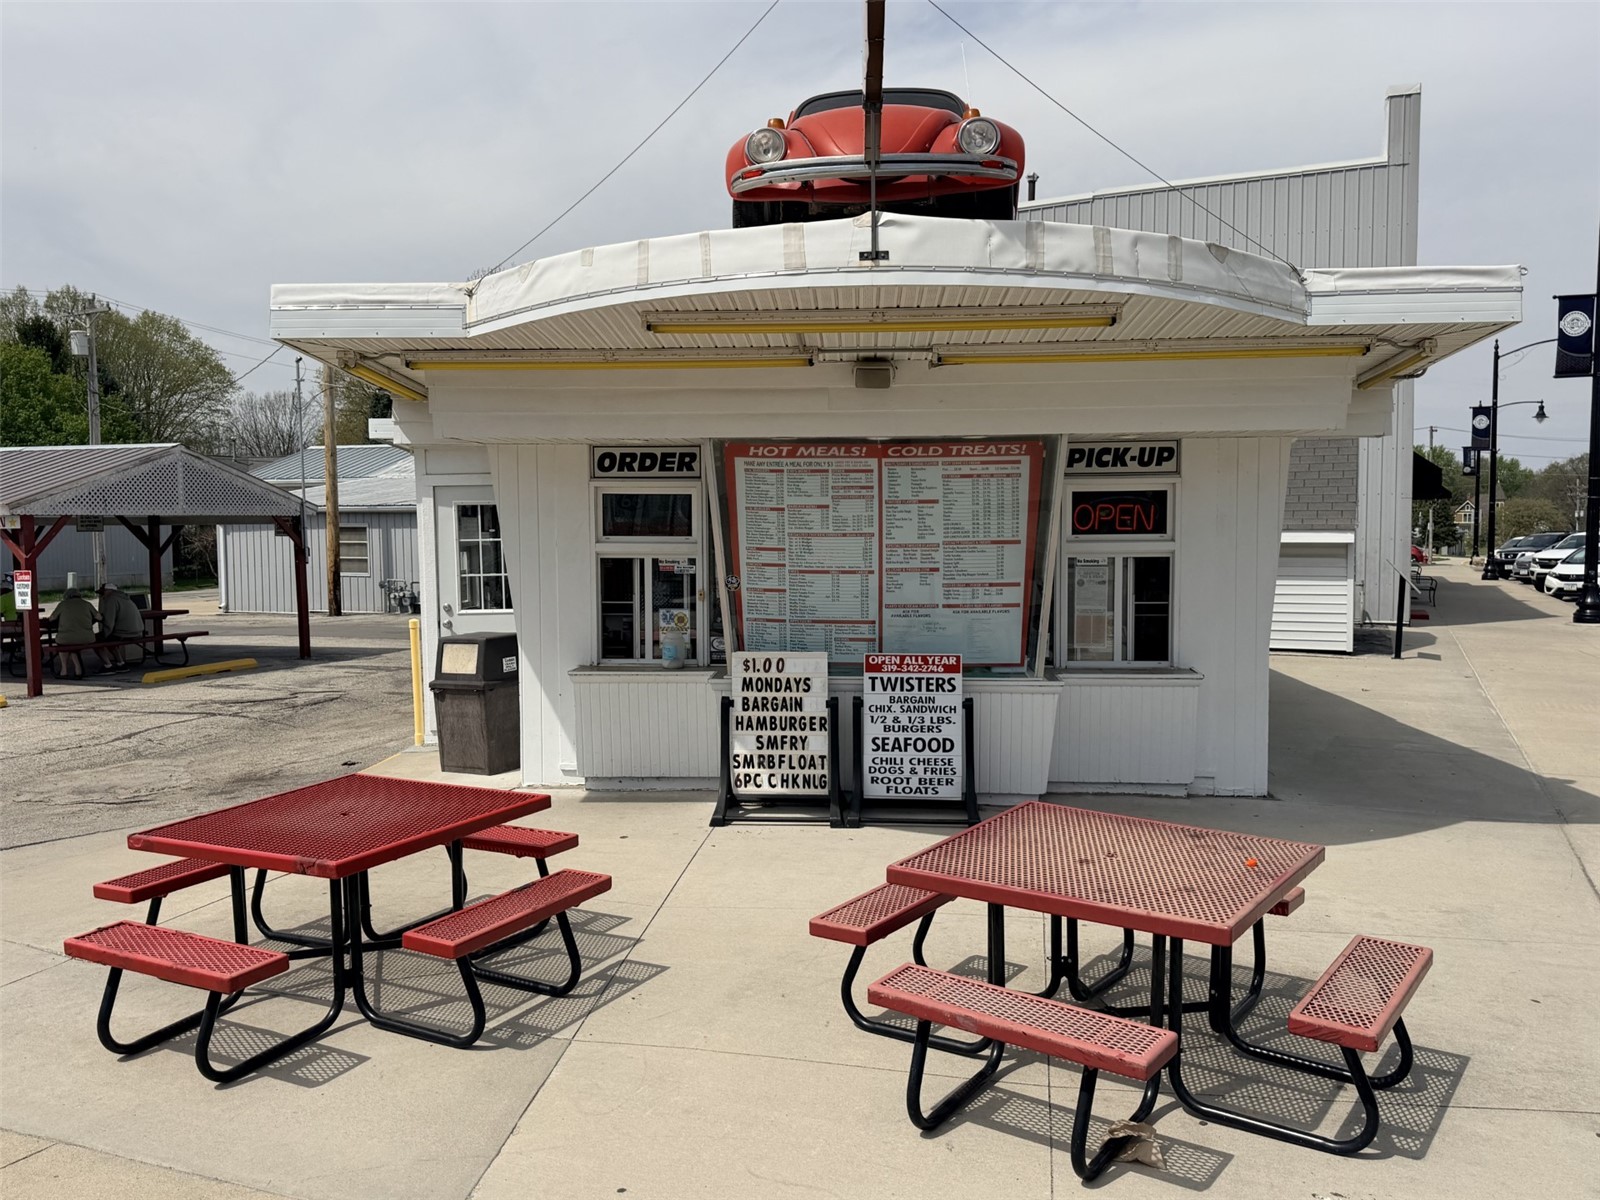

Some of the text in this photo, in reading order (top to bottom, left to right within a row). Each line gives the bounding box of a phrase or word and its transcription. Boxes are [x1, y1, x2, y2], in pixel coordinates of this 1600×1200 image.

[749, 446, 867, 457] HOT MEALS!
[888, 444, 1027, 457] COLD TREATS!
[597, 451, 697, 473] ORDER
[1066, 446, 1175, 468] PICK-UP
[744, 460, 755, 468] MAKE
[756, 460, 765, 468] ANY
[785, 460, 788, 468] A
[789, 460, 802, 468] MEAL
[803, 460, 813, 468] FOR
[814, 460, 826, 468] ONLY
[1074, 504, 1154, 531] OPEN
[868, 656, 957, 665] OPEN ALL YEAR
[881, 664, 944, 673] 319-342-2746
[741, 677, 811, 693] MONDAYS
[868, 676, 957, 693] TWISTERS
[742, 696, 803, 712] BARGAIN
[889, 696, 936, 705] BARGAIN
[868, 705, 957, 714] CHIX. SANDWICH
[735, 715, 828, 732] HAMBURGER
[869, 715, 956, 725] 1/2 & 1/3 LBS.
[883, 725, 942, 733] BURGERS
[871, 736, 955, 753] SEAFOOD
[871, 756, 954, 766] CHILI CHEESE
[868, 766, 957, 776] DOGS & FRIES
[734, 773, 762, 789] 6PC
[870, 776, 955, 786] ROOT BEER
[886, 786, 939, 795] FLOATS
